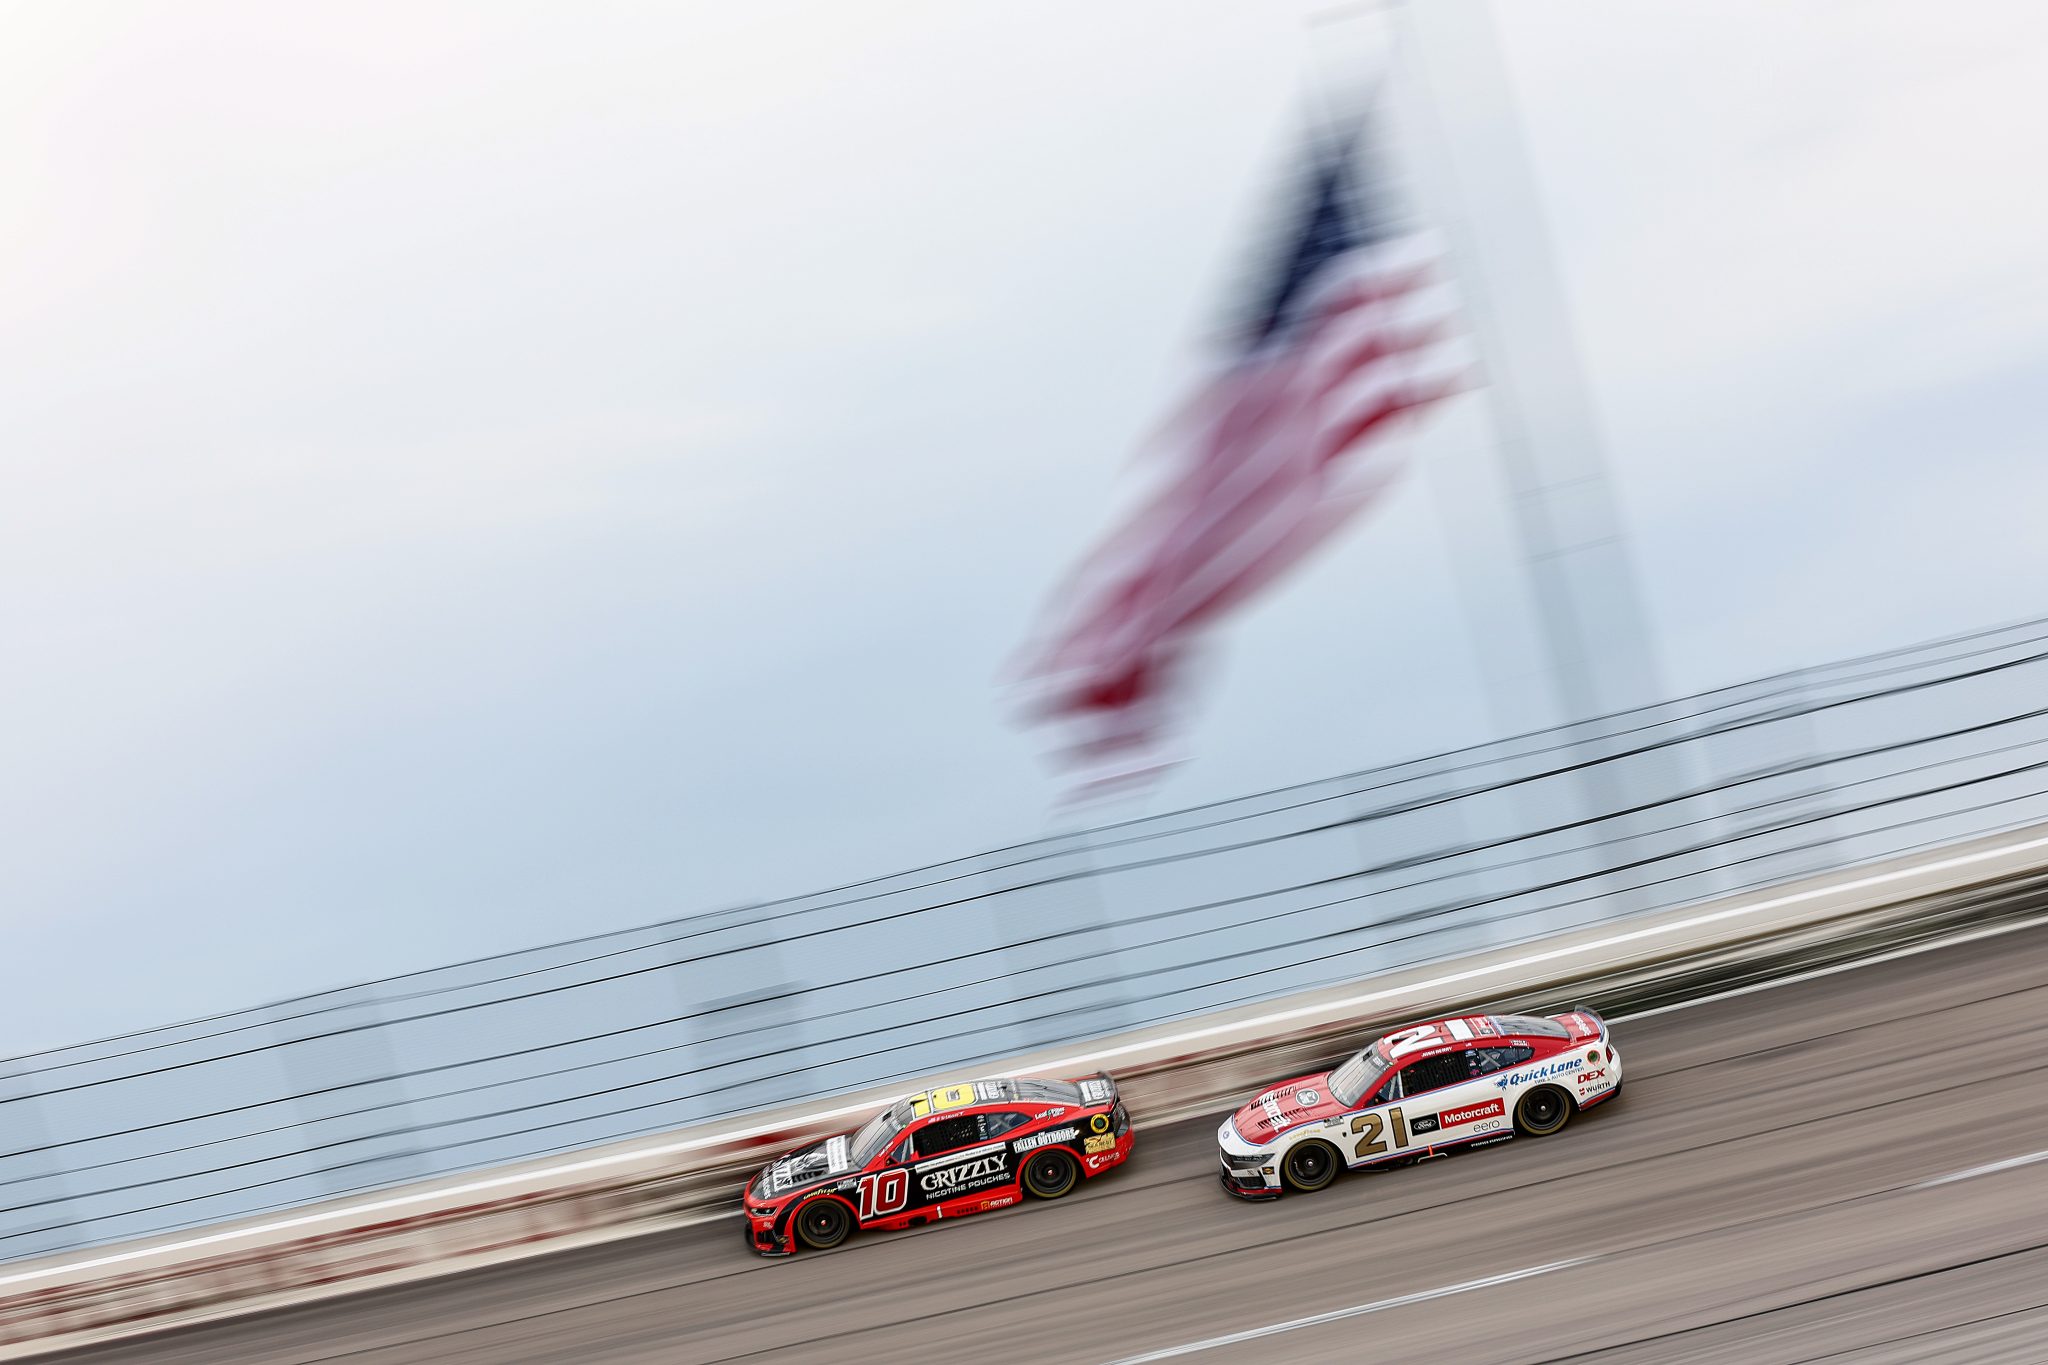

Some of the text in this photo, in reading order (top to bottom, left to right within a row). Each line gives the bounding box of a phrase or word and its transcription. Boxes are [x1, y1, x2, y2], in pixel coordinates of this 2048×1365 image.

[1509, 1058, 1583, 1086] Quick Lane
[1578, 1068, 1606, 1085] DEX
[1444, 1102, 1500, 1124] Motorcraft
[1473, 1119, 1500, 1133] eero
[1012, 1128, 1077, 1154] FALLEN OUTDOORS
[1350, 1106, 1409, 1159] 21
[920, 1153, 1008, 1191] GRIZZLY
[856, 1168, 910, 1222] 10
[925, 1172, 1011, 1201] NICOTINE POUCHES
